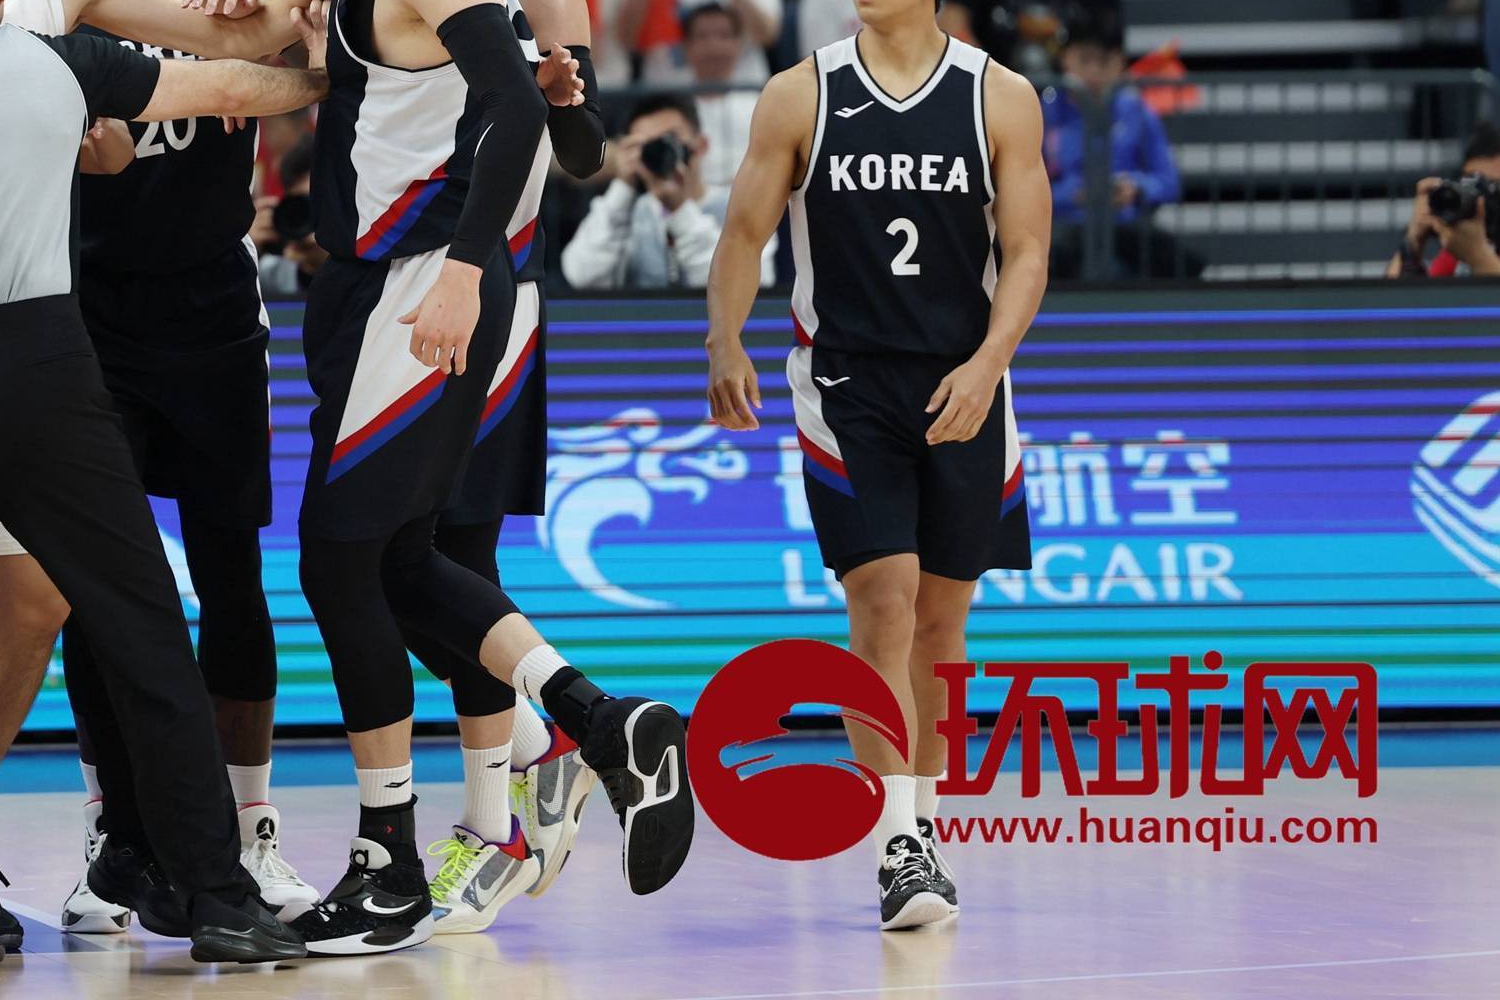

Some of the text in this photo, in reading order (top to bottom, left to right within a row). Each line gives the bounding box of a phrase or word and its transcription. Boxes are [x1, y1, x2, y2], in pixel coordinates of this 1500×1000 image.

[828, 153, 969, 193] KOREA
[885, 217, 921, 276] 2
[783, 543, 1244, 604] LNGAIR
